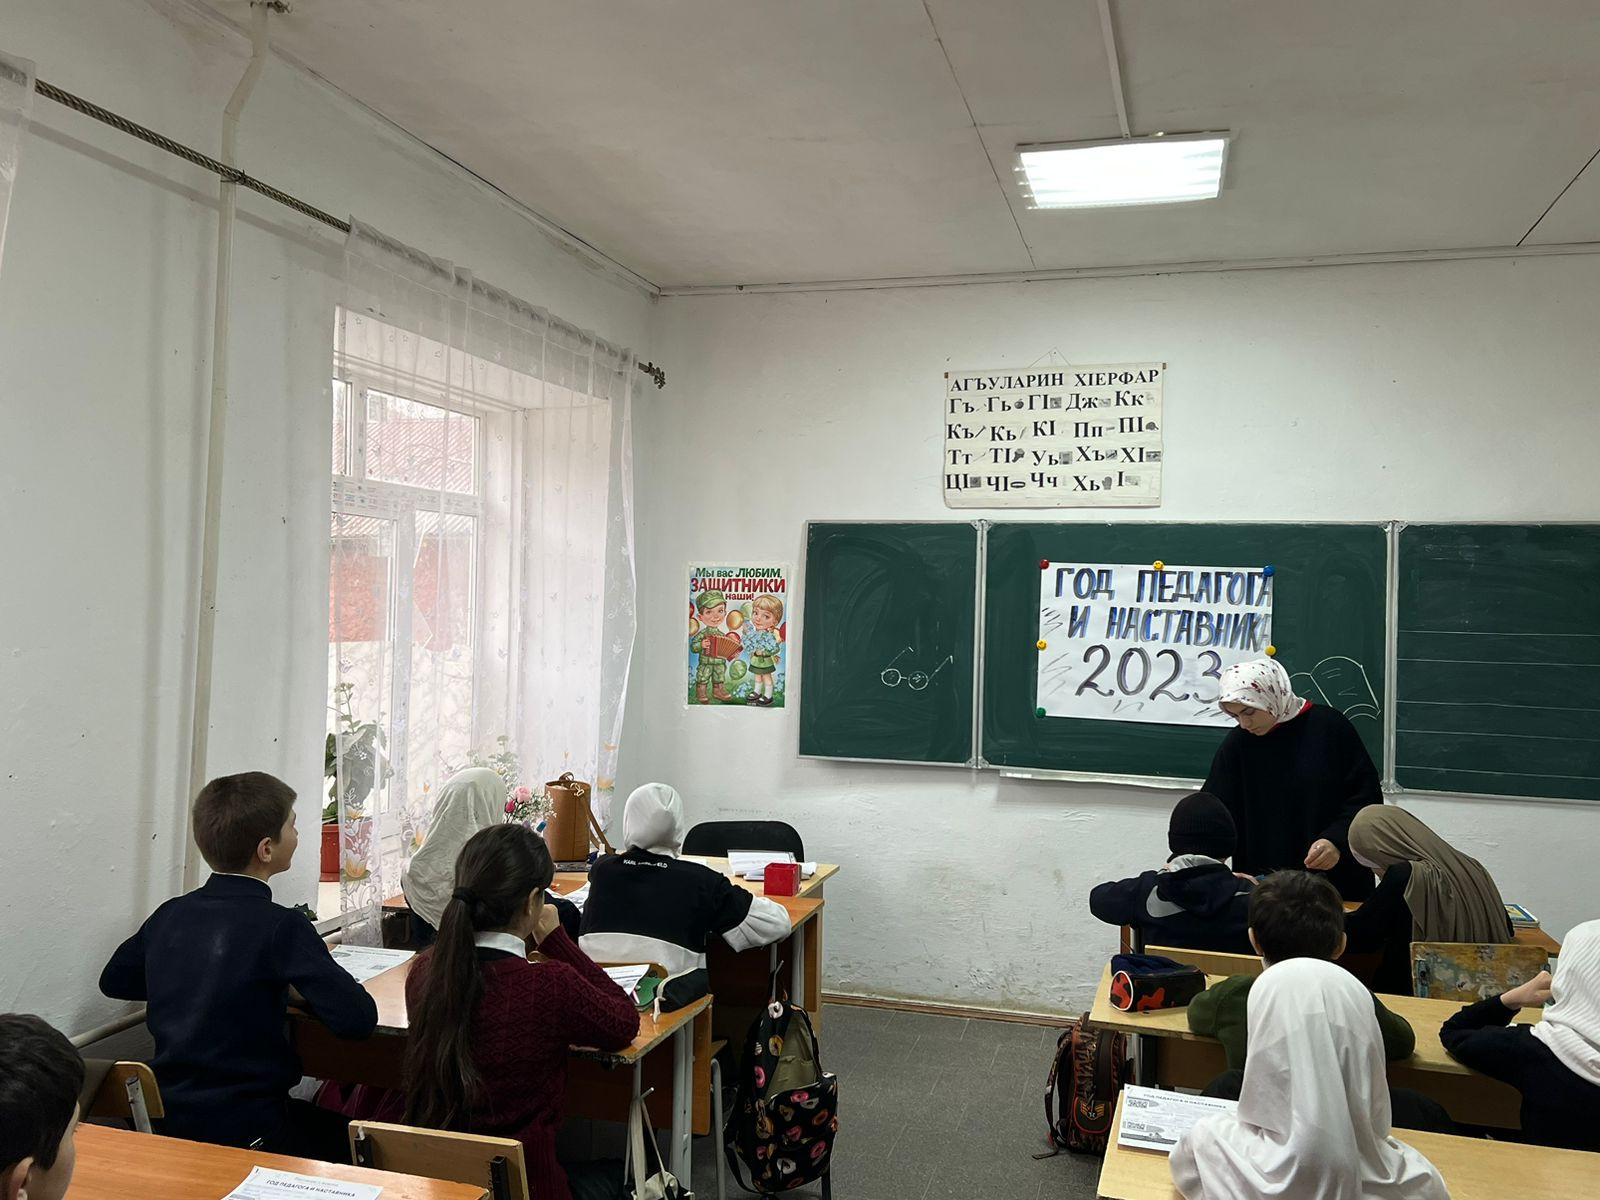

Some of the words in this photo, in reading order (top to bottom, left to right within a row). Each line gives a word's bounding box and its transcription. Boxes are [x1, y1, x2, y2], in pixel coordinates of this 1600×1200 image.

[950, 373, 1063, 391] АГЪУЛАРИН
[950, 398, 975, 413] Гъ
[987, 396, 1011, 412] Гь
[1065, 393, 1098, 412] Дж
[1115, 390, 1144, 406] Кк
[947, 424, 974, 439] Къ
[990, 426, 1016, 441] Кь
[1074, 422, 1102, 438] Пп
[948, 449, 973, 464] Тт
[1076, 446, 1105, 462] Хъ
[1030, 472, 1058, 488] Чч
[1072, 475, 1100, 491] Хь
[695, 568, 714, 578] Мы
[735, 568, 783, 579] ЛЮБИМ,
[690, 578, 786, 593] ЗАЩИТНИКИ
[1055, 568, 1115, 601] ГОД
[1136, 569, 1272, 607] ПЕДАГОГА
[725, 593, 754, 601] наши!
[1068, 605, 1091, 638] И
[1106, 606, 1272, 652] НАСТАВНИКА
[1075, 644, 1222, 703] 2023
[280, 1182, 309, 1190] ПЕДАГОГА
[315, 1188, 355, 1197] НАСТАВНИКА
